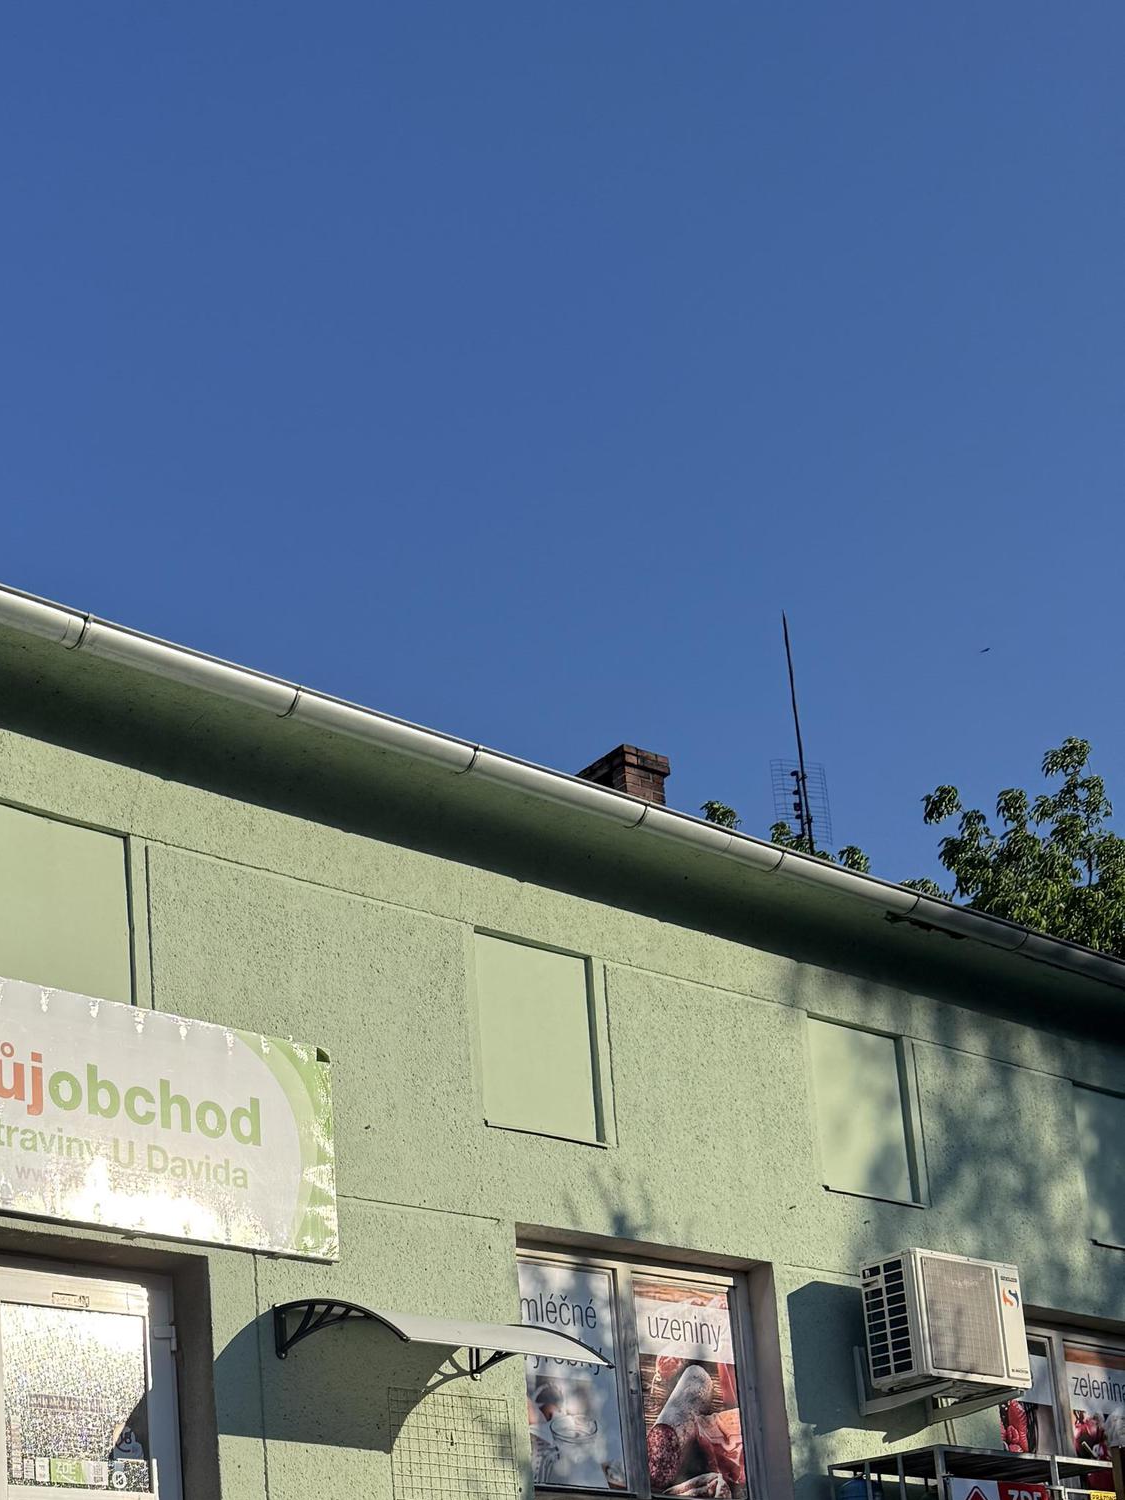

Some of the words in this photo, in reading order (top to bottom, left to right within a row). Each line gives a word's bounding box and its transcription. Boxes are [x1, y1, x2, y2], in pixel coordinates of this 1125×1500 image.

[113, 1141, 137, 1171] U
[147, 1143, 250, 1190] Davida
[520, 1292, 597, 1330] mléčné
[647, 1314, 722, 1354] uzeniny
